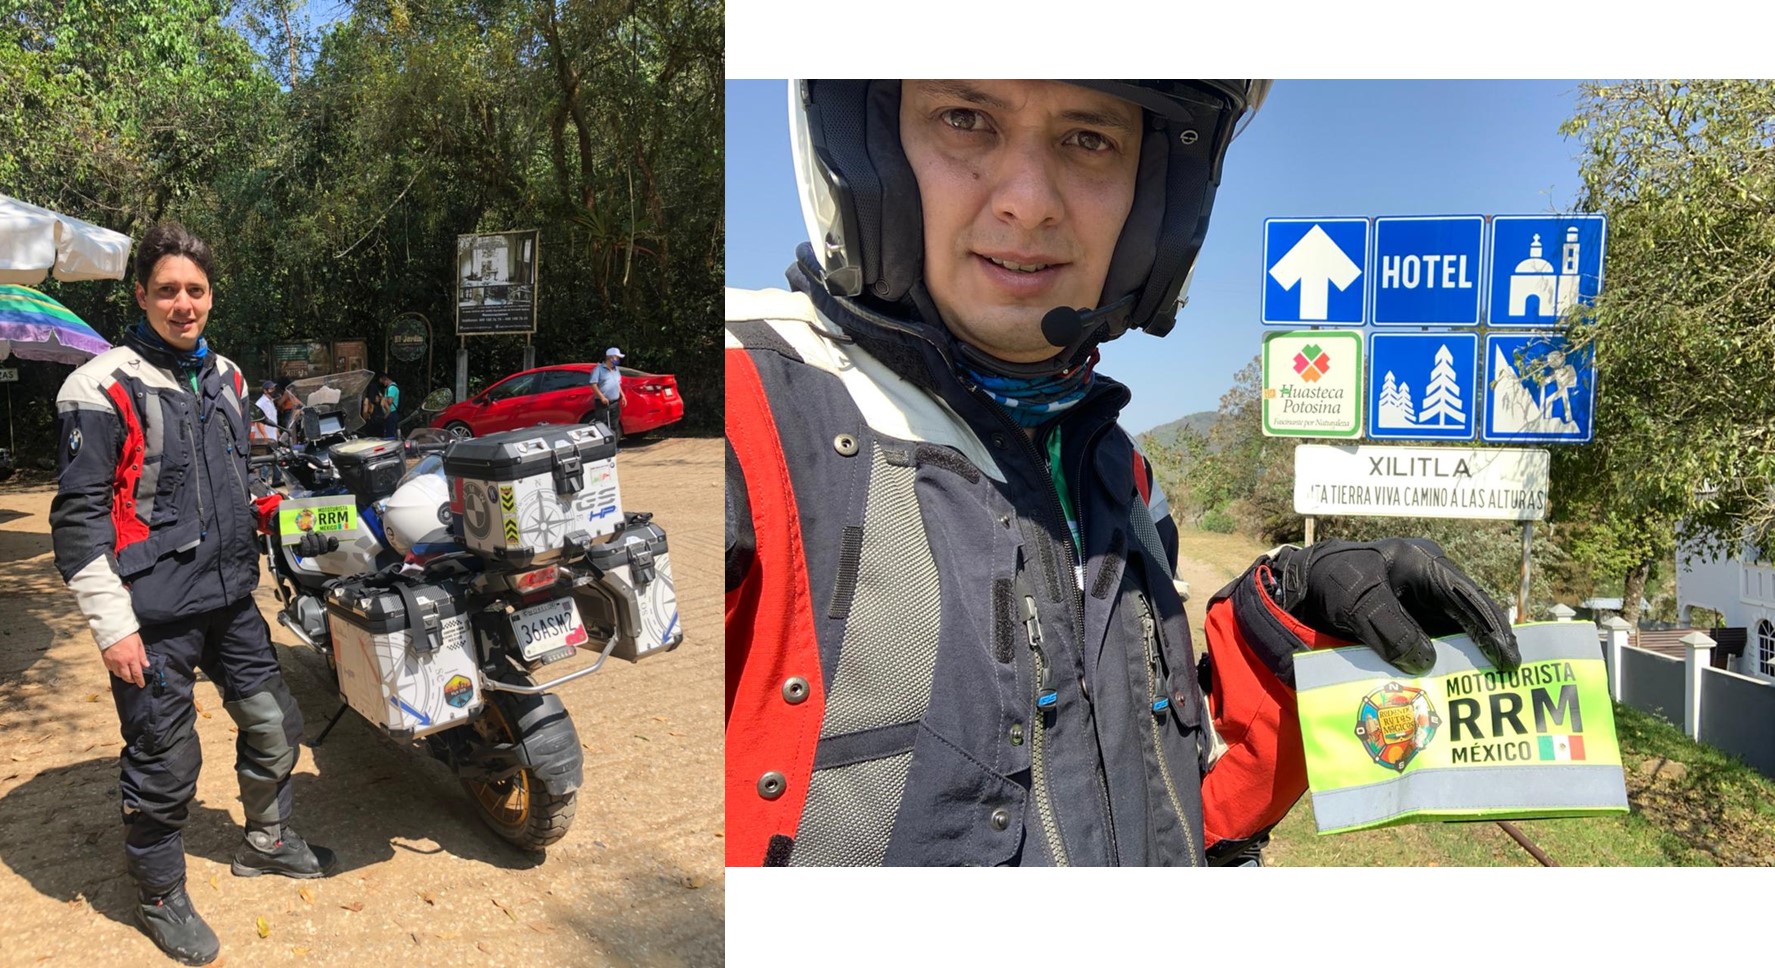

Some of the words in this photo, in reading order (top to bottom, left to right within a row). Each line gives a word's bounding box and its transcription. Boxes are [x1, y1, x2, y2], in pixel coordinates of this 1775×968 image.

[1382, 254, 1473, 289] HOTEL
[0, 371, 14, 379] AS
[1280, 384, 1344, 399] Huasteca
[1283, 399, 1341, 414] Potosina
[1369, 457, 1472, 478] XILITLA
[576, 486, 616, 512] GS
[1331, 485, 1371, 505] TIERRA
[1374, 486, 1400, 506] VIVA
[1404, 486, 1448, 507] CAMINO
[1461, 488, 1486, 508] LAS
[1488, 489, 1544, 510] ALTURAS
[319, 511, 349, 525] RRM
[589, 505, 616, 522] HP
[521, 612, 577, 645] 36ASM2
[1446, 662, 1577, 698] MOTOTURISTA
[1448, 684, 1583, 742] RRM
[1452, 741, 1532, 764] MÉXICO
